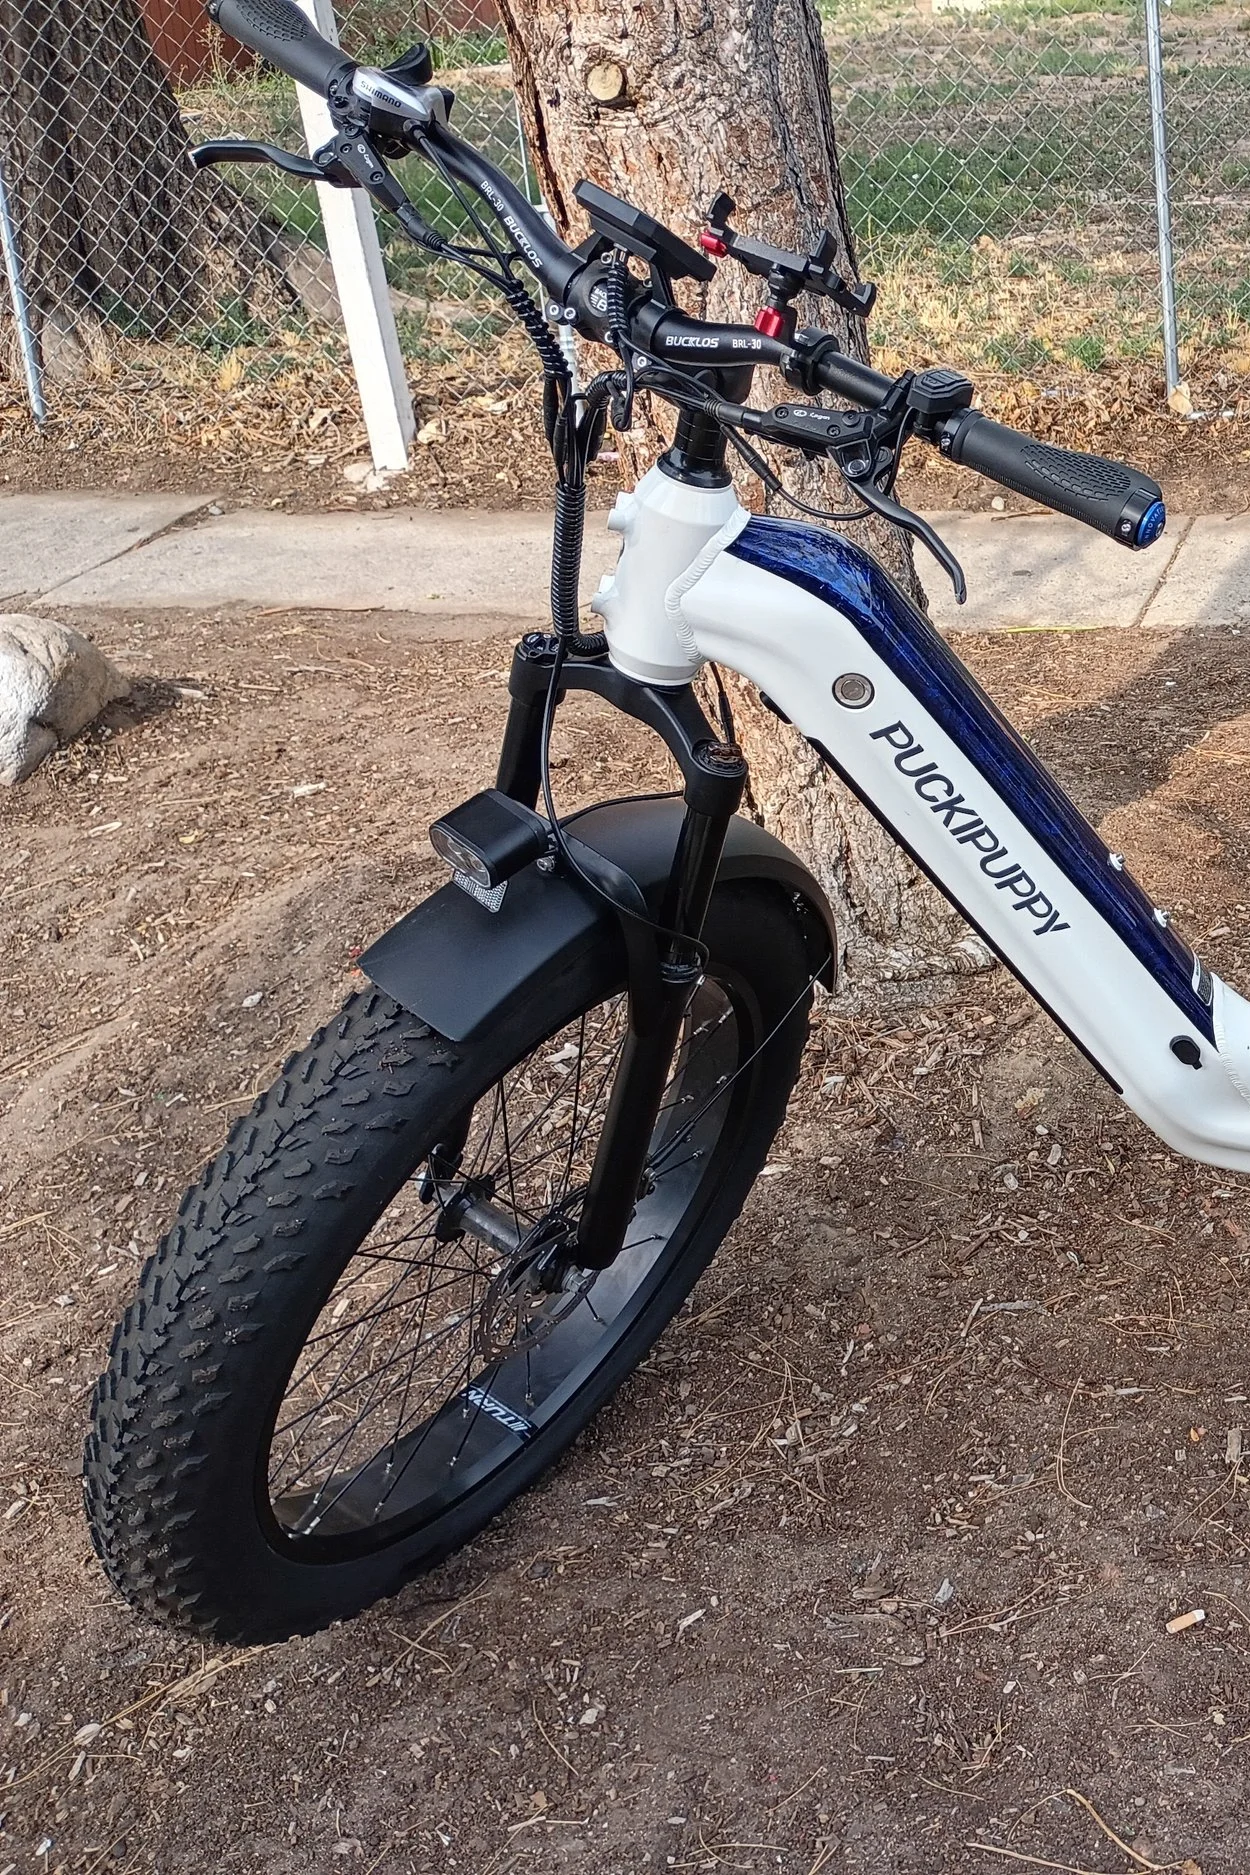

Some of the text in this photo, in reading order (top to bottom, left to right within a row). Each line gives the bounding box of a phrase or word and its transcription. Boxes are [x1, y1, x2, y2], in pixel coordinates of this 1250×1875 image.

[360, 80, 402, 108] SHIMANO
[480, 180, 543, 268] BRL-30 BUCKLOS
[665, 336, 762, 350] BUCKLOS BRL-30
[869, 719, 1071, 936] PUCKIPUPPY
